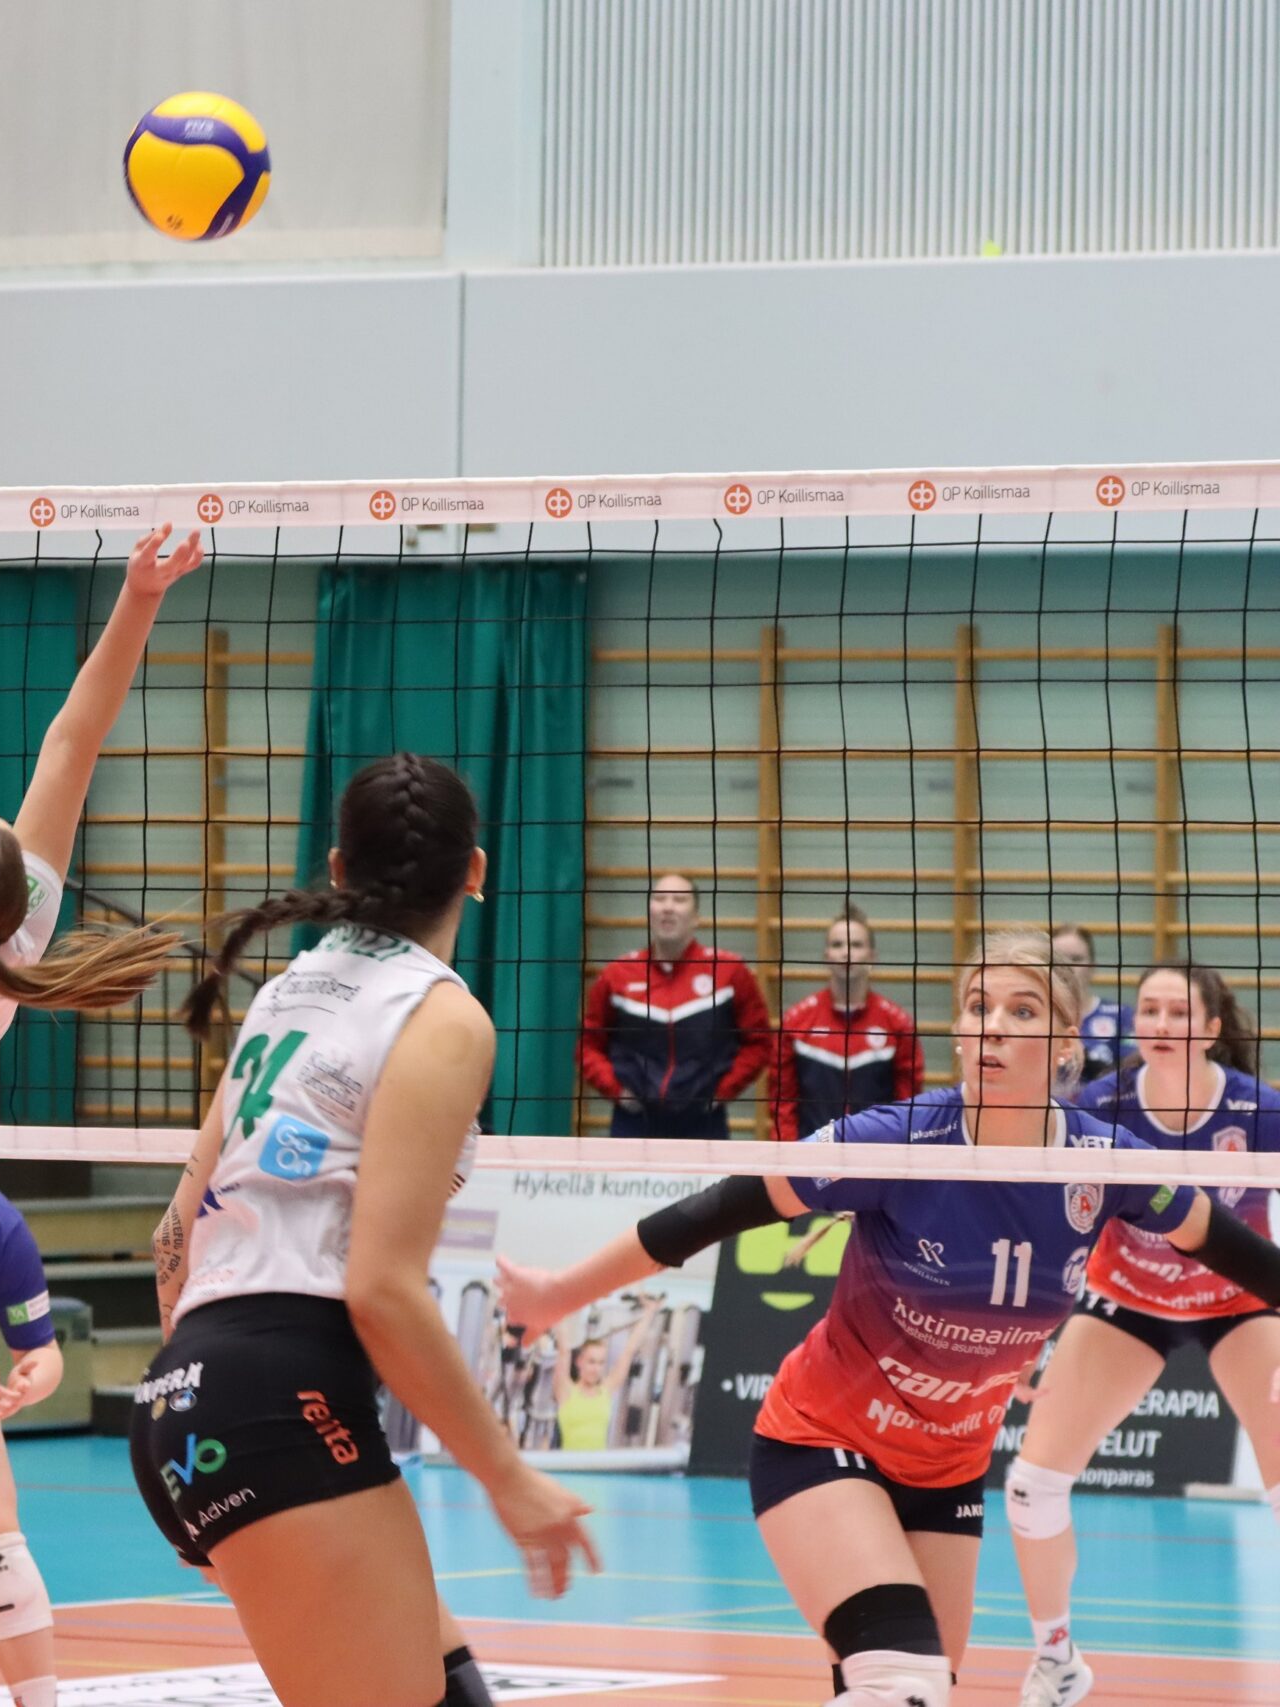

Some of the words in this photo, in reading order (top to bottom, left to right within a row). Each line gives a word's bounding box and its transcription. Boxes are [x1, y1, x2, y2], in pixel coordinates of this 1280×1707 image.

[757, 489, 776, 505] OP
[779, 486, 845, 504] Koillismaa
[942, 485, 961, 502] OP
[964, 482, 1030, 501] Koillismaa
[1131, 482, 1151, 498] OP
[1153, 479, 1220, 498] Koillismaa
[228, 501, 246, 517] OP
[248, 499, 309, 516] Koillismaa
[401, 497, 419, 513] OP
[422, 495, 484, 512] Koillismaa
[577, 494, 596, 510] OP
[598, 492, 662, 509] Koillismaa
[60, 505, 78, 519] OP
[80, 503, 140, 519] Koillismaa
[514, 1172, 595, 1200] Hykellä
[989, 1238, 1033, 1308] 11
[1098, 1430, 1162, 1458] ELUT
[160, 1432, 228, 1503] EVO
[197, 1487, 257, 1529] Adven
